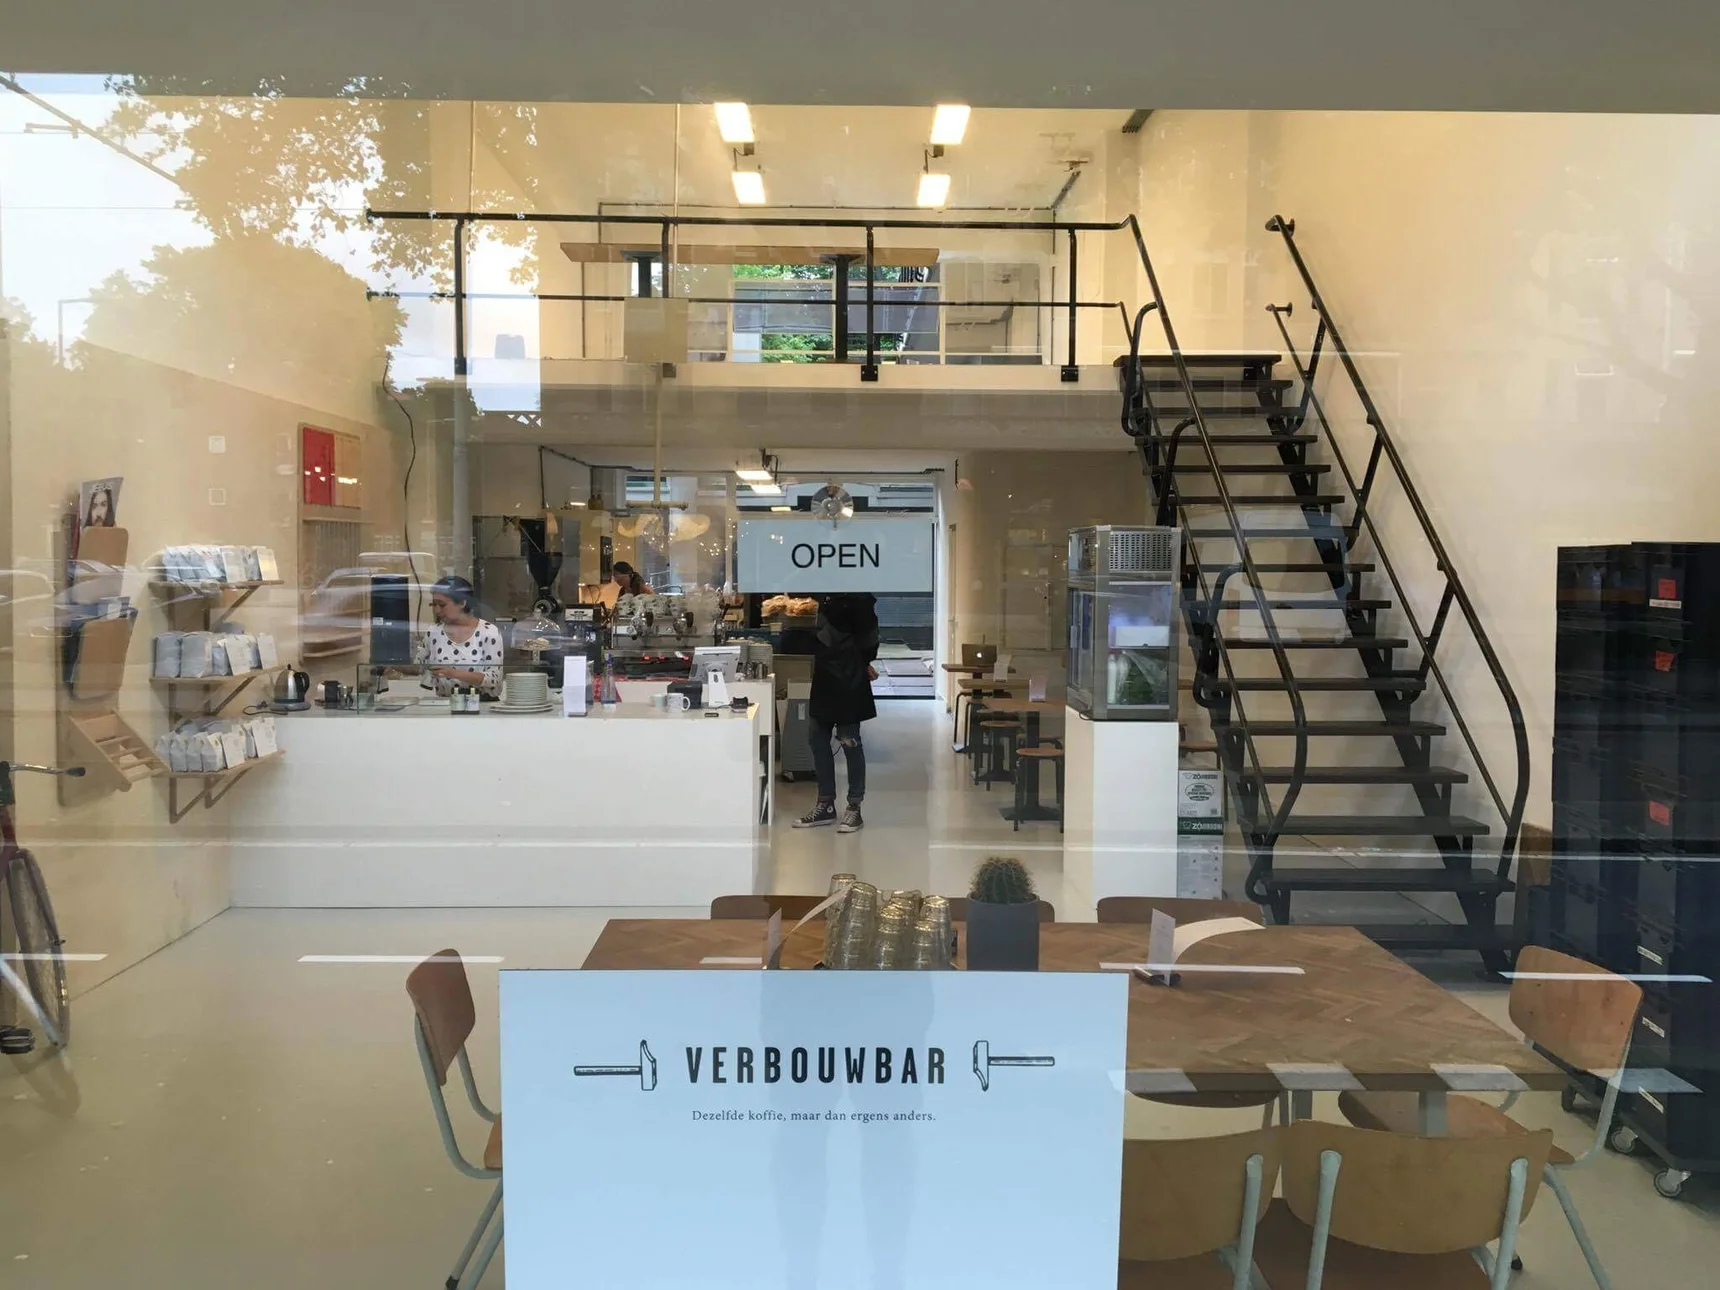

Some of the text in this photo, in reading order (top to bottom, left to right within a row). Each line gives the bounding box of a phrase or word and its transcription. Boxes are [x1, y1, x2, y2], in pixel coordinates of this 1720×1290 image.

[791, 543, 880, 569] OPEN
[685, 1046, 945, 1085] VERBOUWBAR
[692, 1109, 937, 1124] Dezelfde koffie, maar dan ergens anders.
